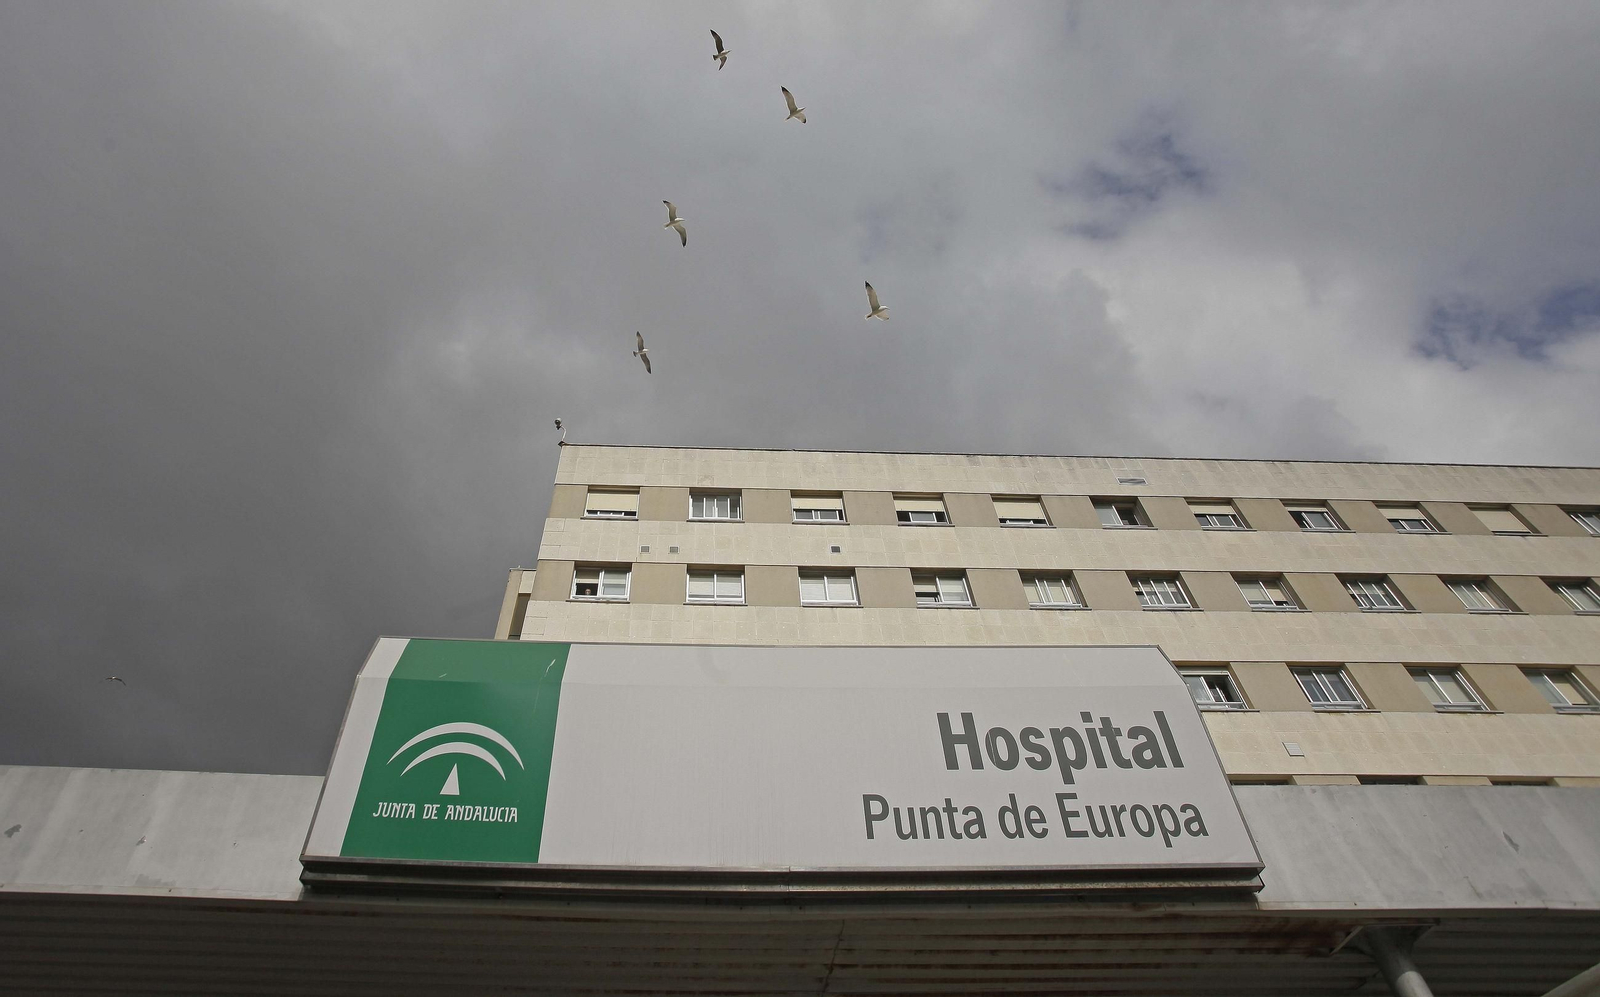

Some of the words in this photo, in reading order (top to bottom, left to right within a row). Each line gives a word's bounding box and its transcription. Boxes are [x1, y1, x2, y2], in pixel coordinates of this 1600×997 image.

[936, 711, 1185, 785] Hospital
[372, 802, 416, 819] JUNTA
[422, 804, 441, 820] DE
[445, 805, 518, 823] ANDALUCIA
[862, 794, 988, 841] Punta
[997, 793, 1049, 840] de
[1055, 792, 1210, 849] Europa
